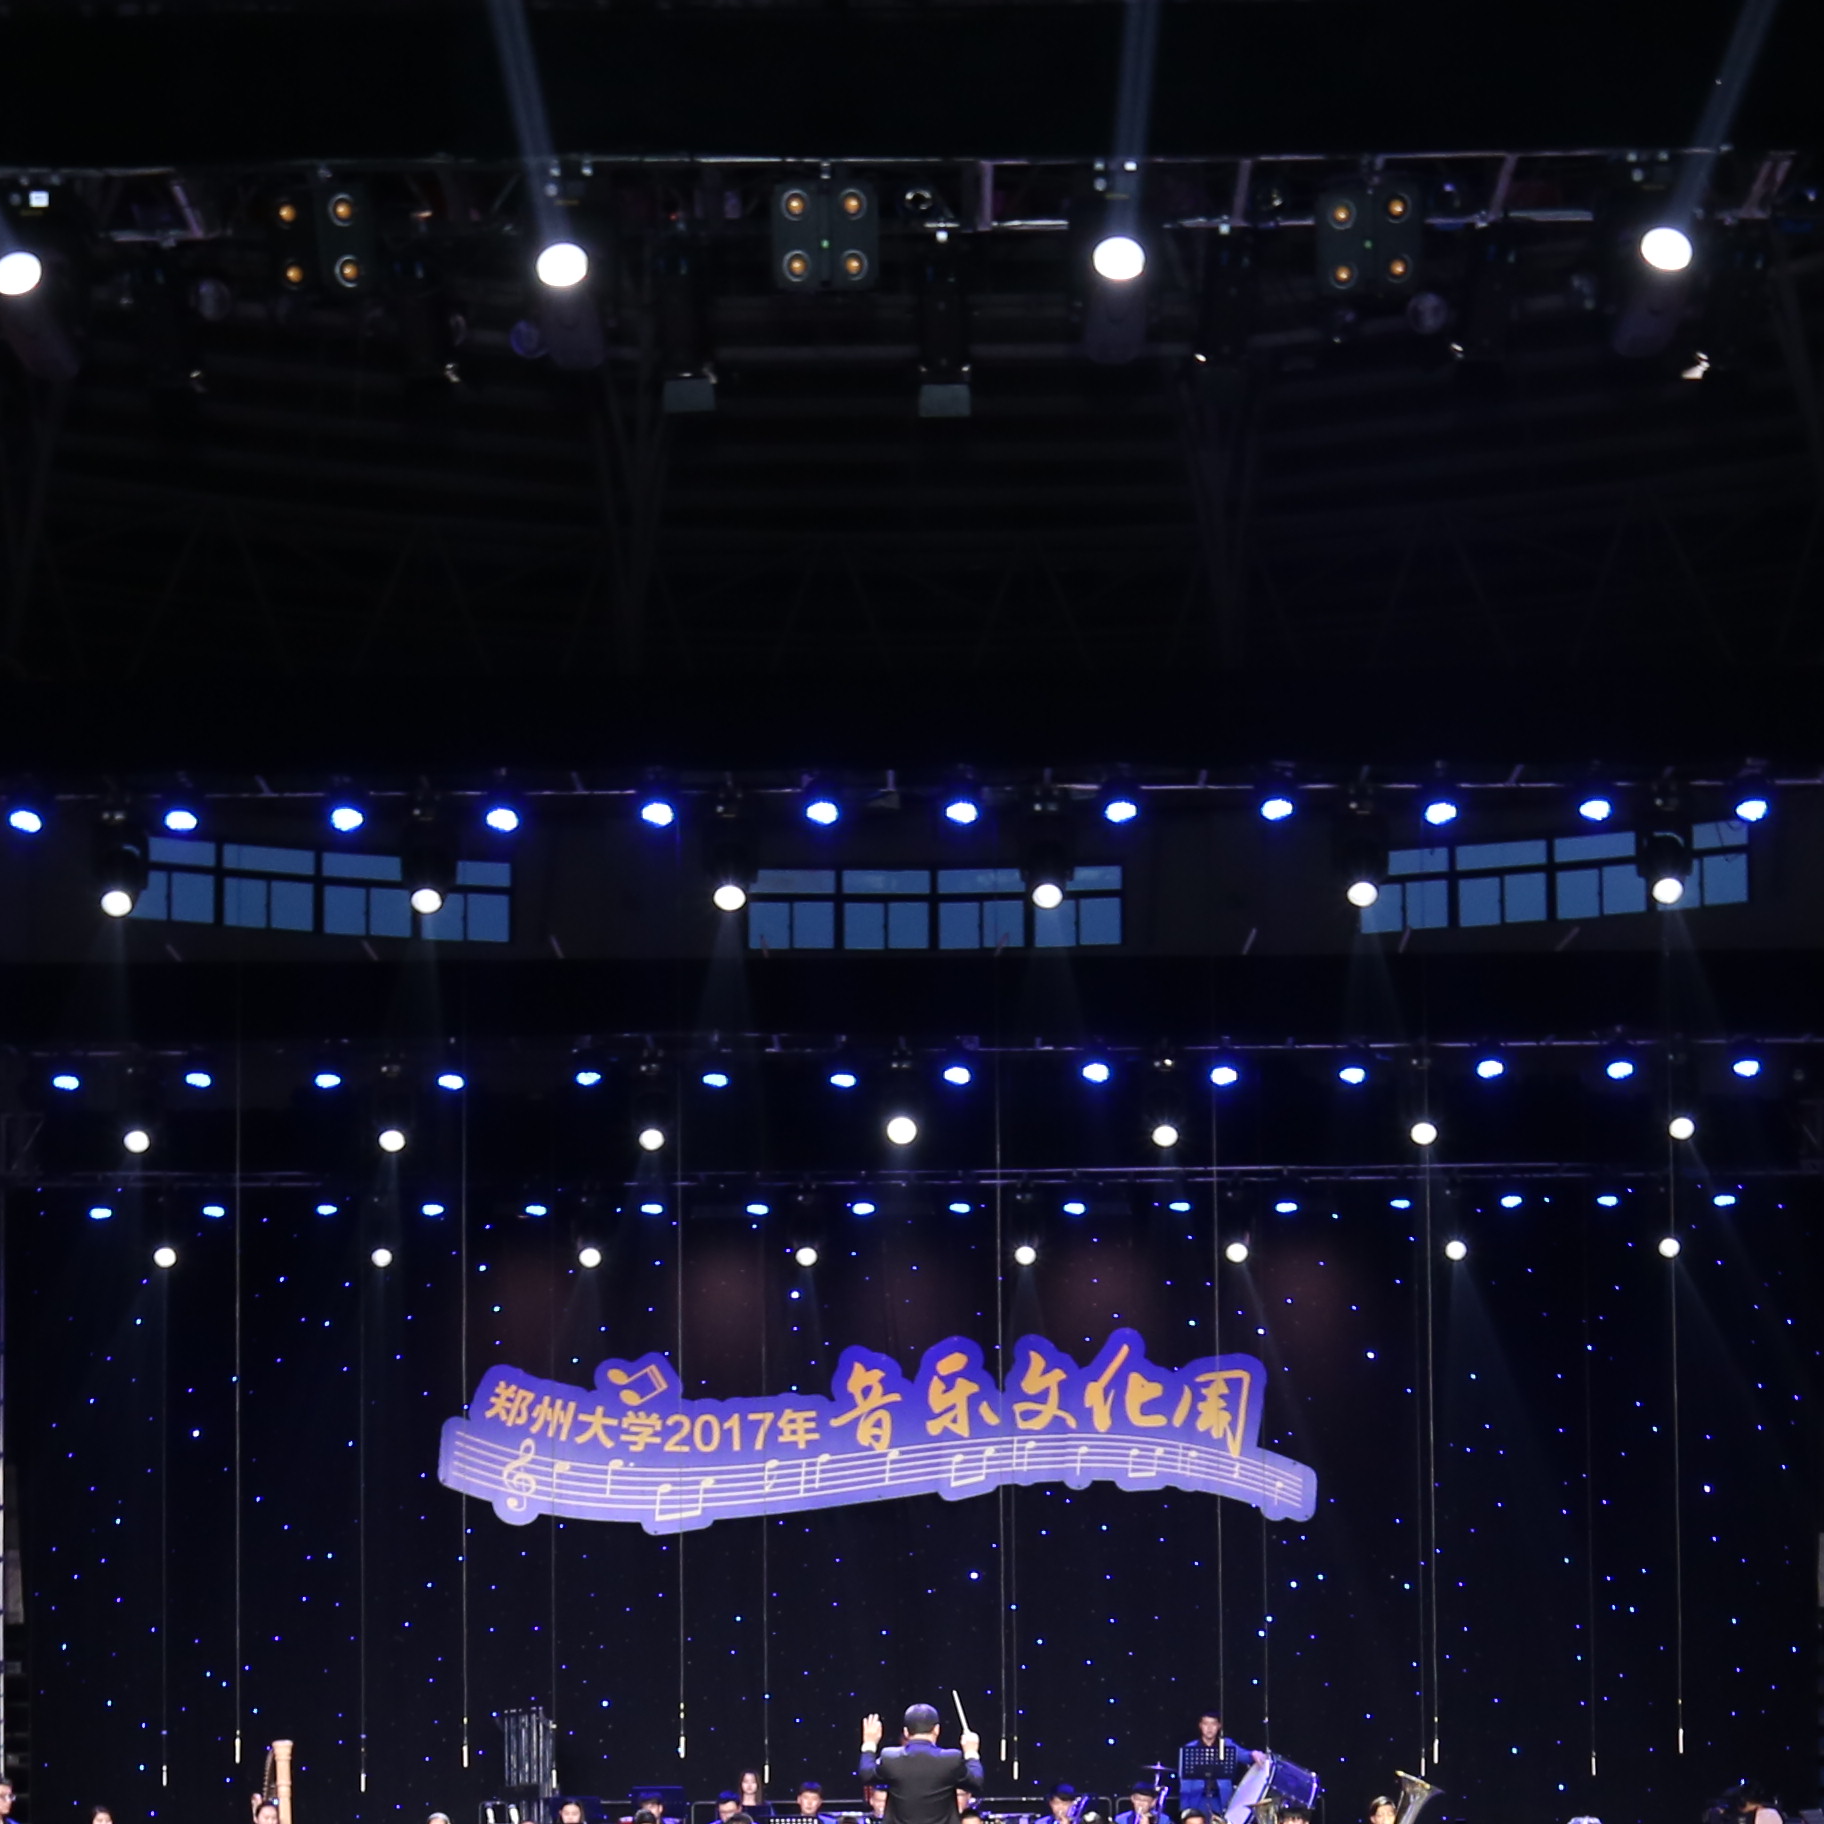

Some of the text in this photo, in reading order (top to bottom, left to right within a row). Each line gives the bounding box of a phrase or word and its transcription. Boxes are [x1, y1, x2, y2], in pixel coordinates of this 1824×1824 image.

[485, 1344, 1251, 1457] 郑州大学2017年 音乐文化周
